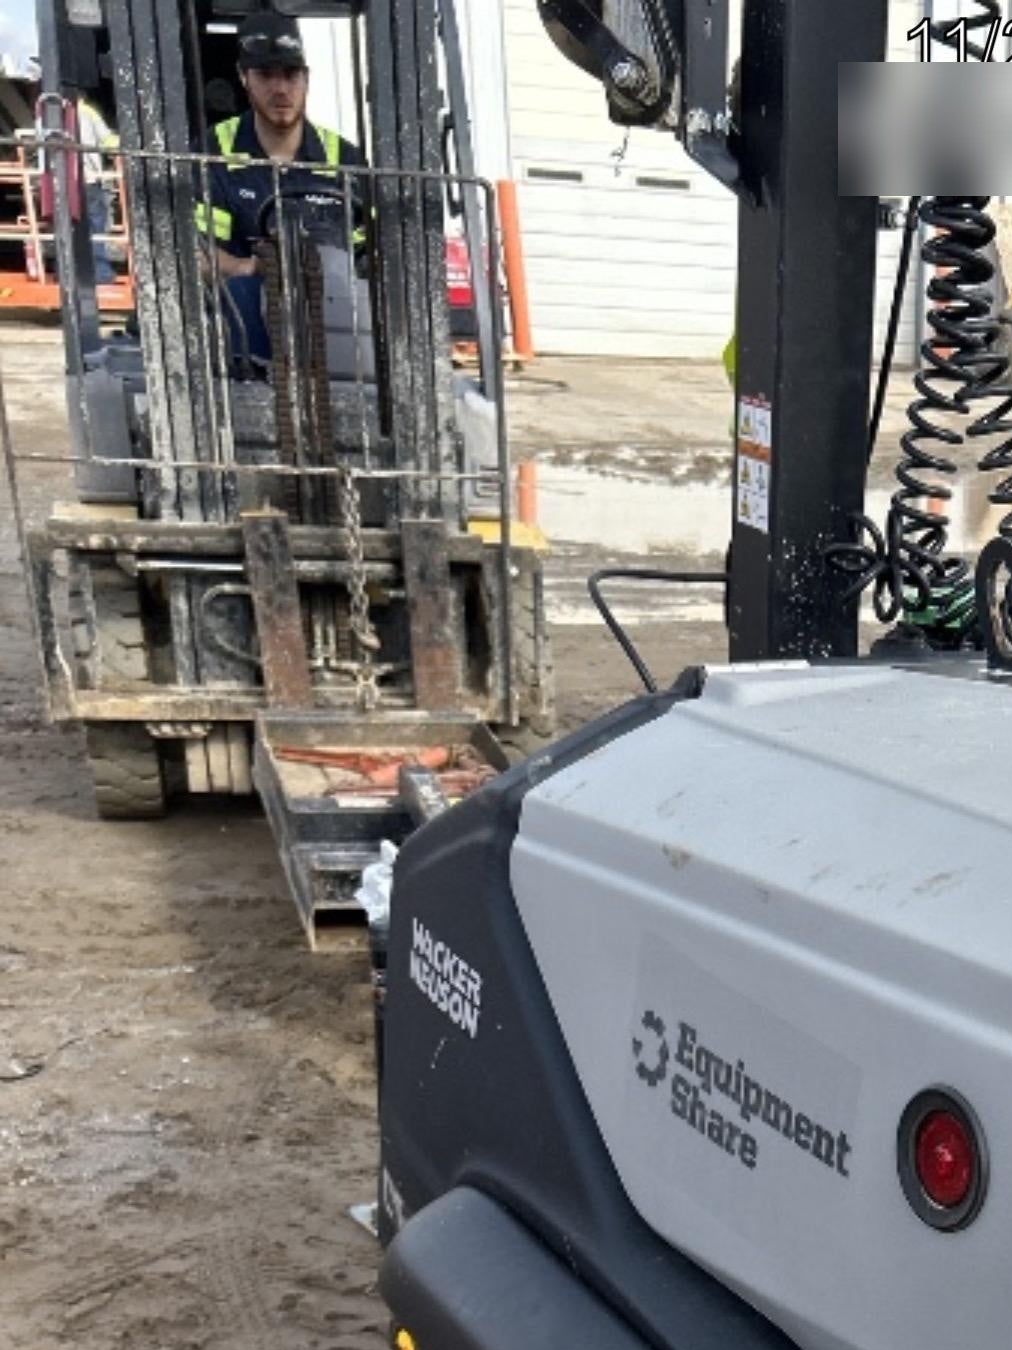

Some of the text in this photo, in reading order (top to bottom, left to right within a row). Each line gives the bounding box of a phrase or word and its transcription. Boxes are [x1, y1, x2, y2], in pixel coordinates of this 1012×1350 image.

[409, 949, 481, 1039] NEUSON
[411, 916, 482, 1007] WACKER
[670, 1072, 758, 1170] Share
[674, 1019, 852, 1179] Equipment
